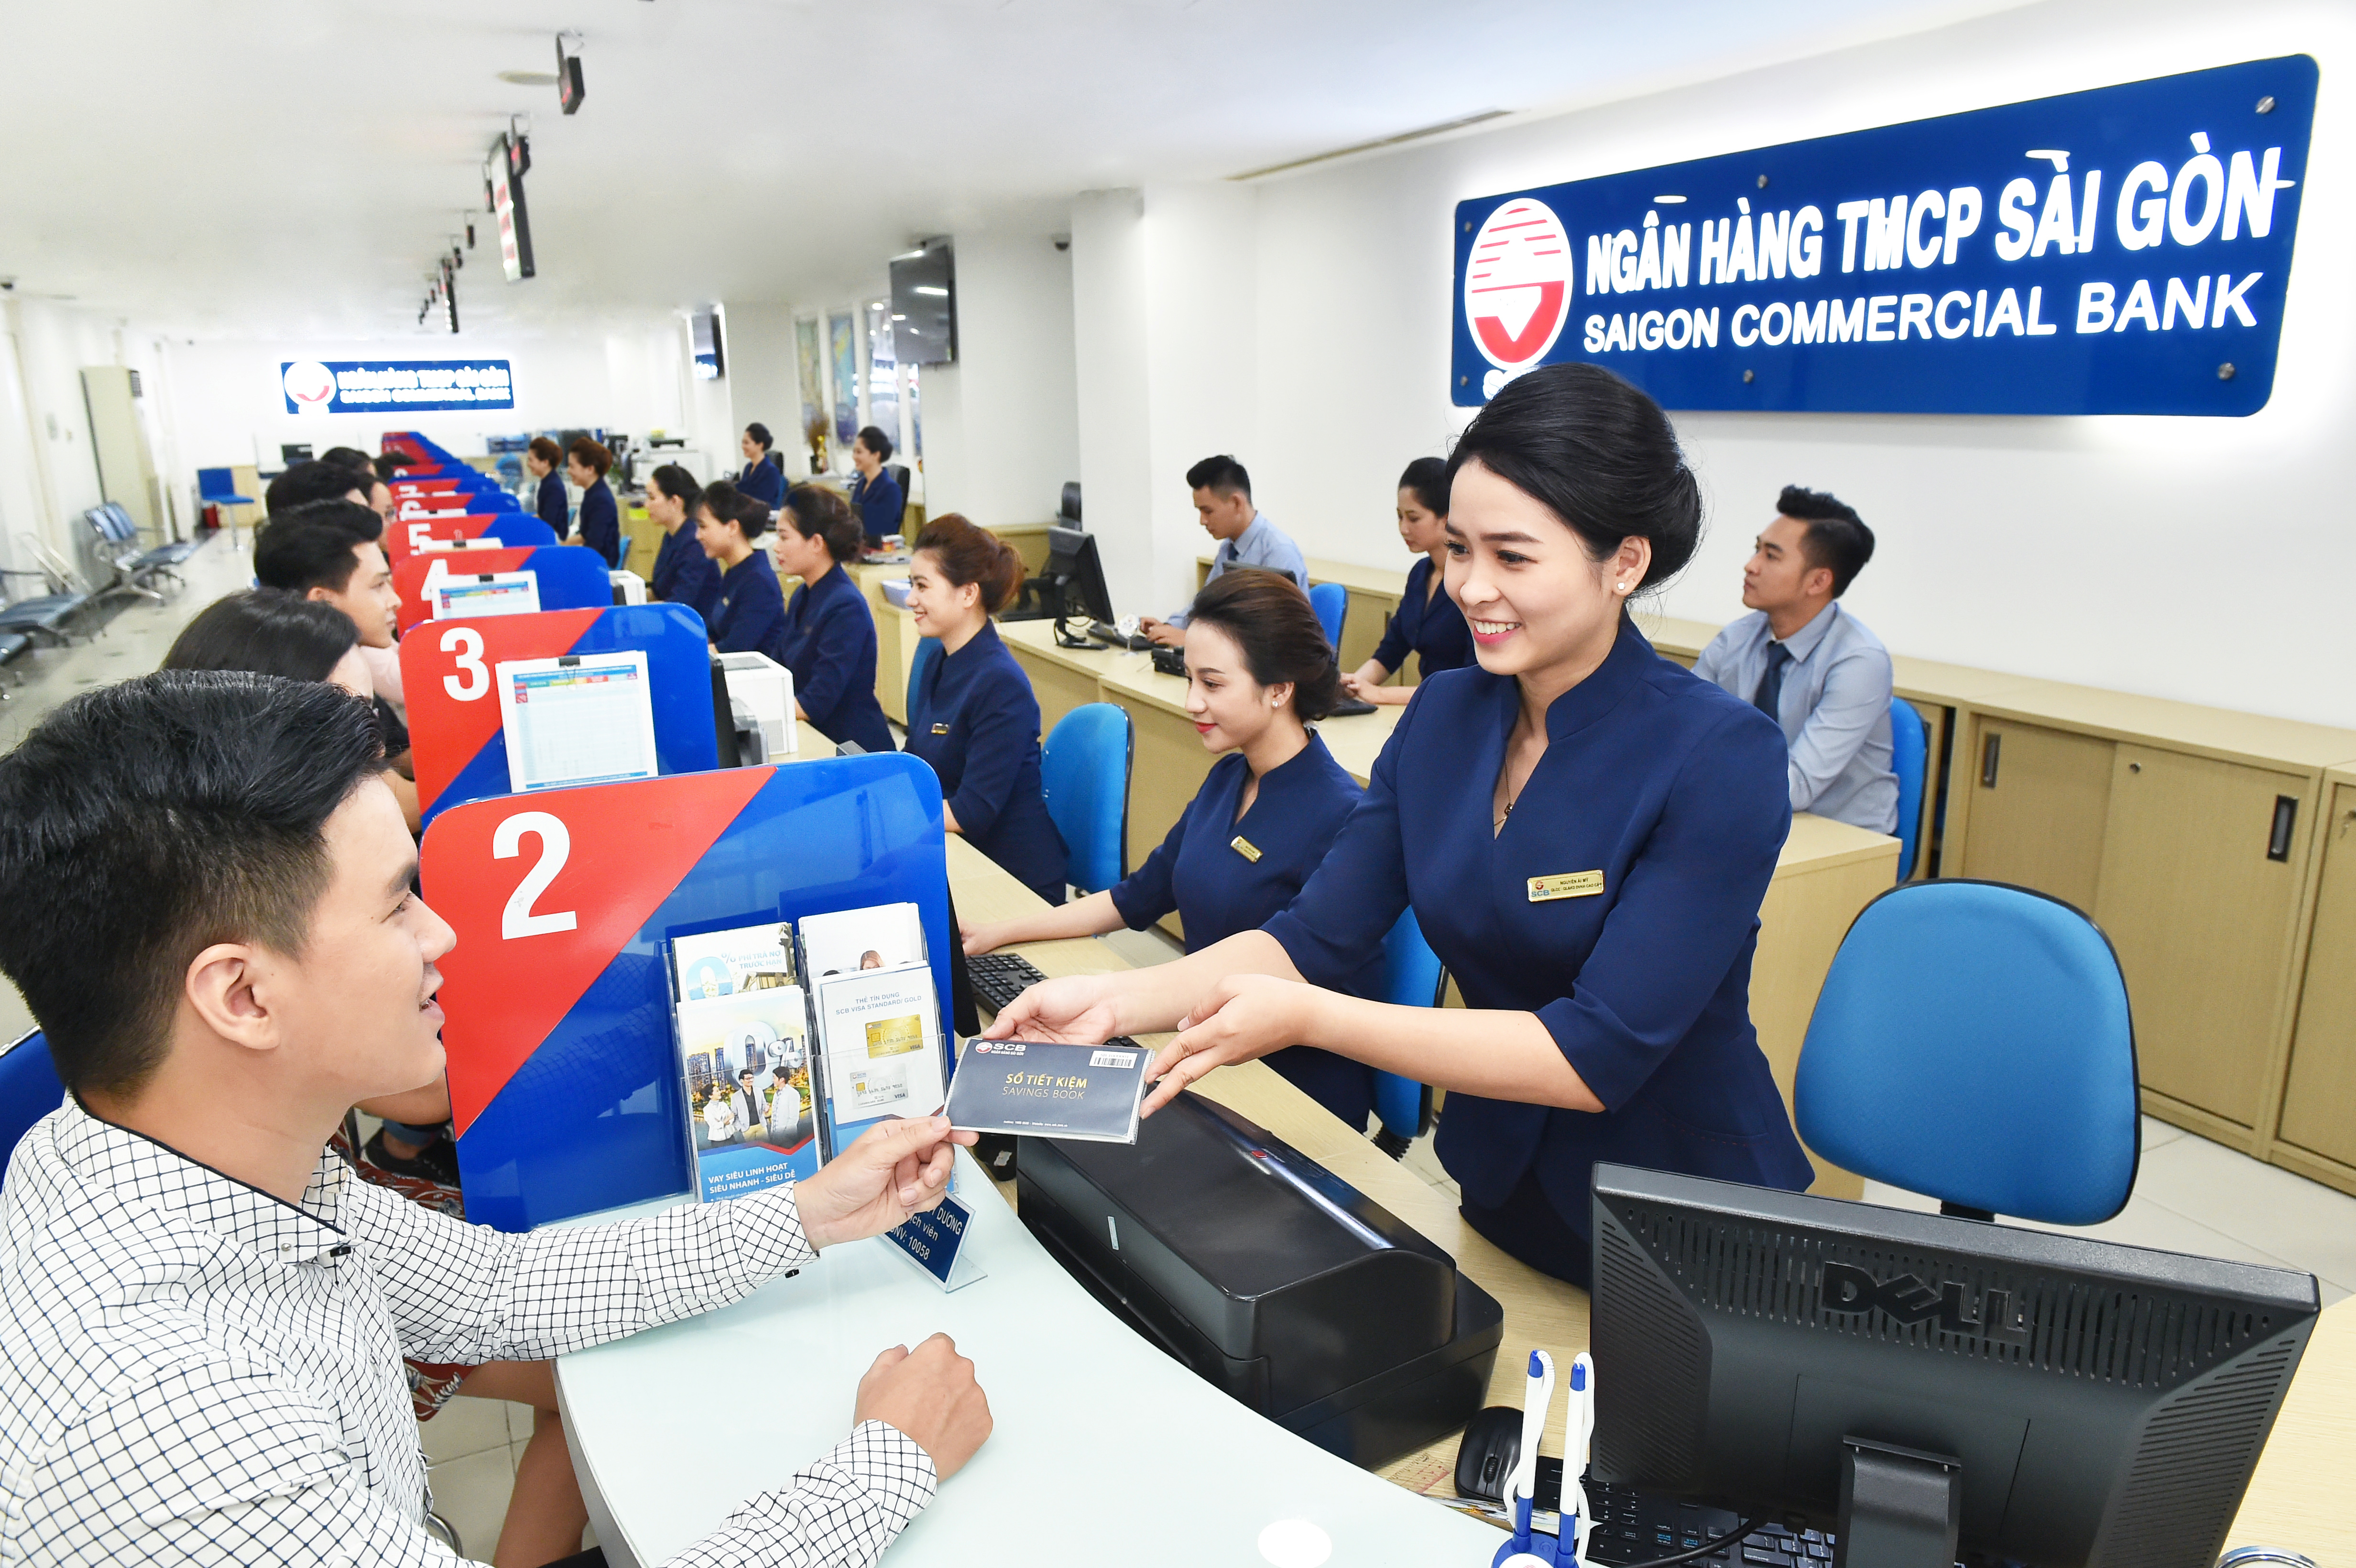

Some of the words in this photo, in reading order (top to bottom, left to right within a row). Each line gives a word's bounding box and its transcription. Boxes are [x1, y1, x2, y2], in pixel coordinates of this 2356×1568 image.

[1586, 210, 1691, 295] NGÂN
[1700, 197, 1823, 285] HÀNG
[1837, 186, 1982, 273] TMCP
[1995, 151, 2102, 261] SÀI
[2116, 131, 2282, 251] GÒN
[1583, 307, 1720, 353] SAIGON
[1731, 286, 2057, 347] COMMERCIAL
[2076, 272, 2264, 334] BANK
[408, 523, 432, 555] 5
[421, 559, 448, 601] 4
[439, 627, 490, 702] 3
[492, 811, 578, 940] 2
[993, 1043, 1026, 1051] SCB
[1002, 1086, 1049, 1098] SAVINGS
[1052, 1089, 1085, 1100] BOOK
[1027, 1073, 1054, 1086] TIẾT
[1056, 1076, 1088, 1090] KIỆM
[708, 1174, 725, 1184] VAY
[726, 1170, 744, 1181] SIÊU
[745, 1166, 765, 1177] LINH
[766, 1162, 788, 1172] HOẠT
[709, 1183, 728, 1194] SIÊU
[730, 1178, 760, 1190] NHANH
[765, 1172, 783, 1183] SIÊU
[923, 1223, 938, 1241] viên
[937, 1207, 963, 1236] DƯƠNG
[908, 1235, 930, 1260] 10058
[1820, 1261, 2027, 1347] DELL
